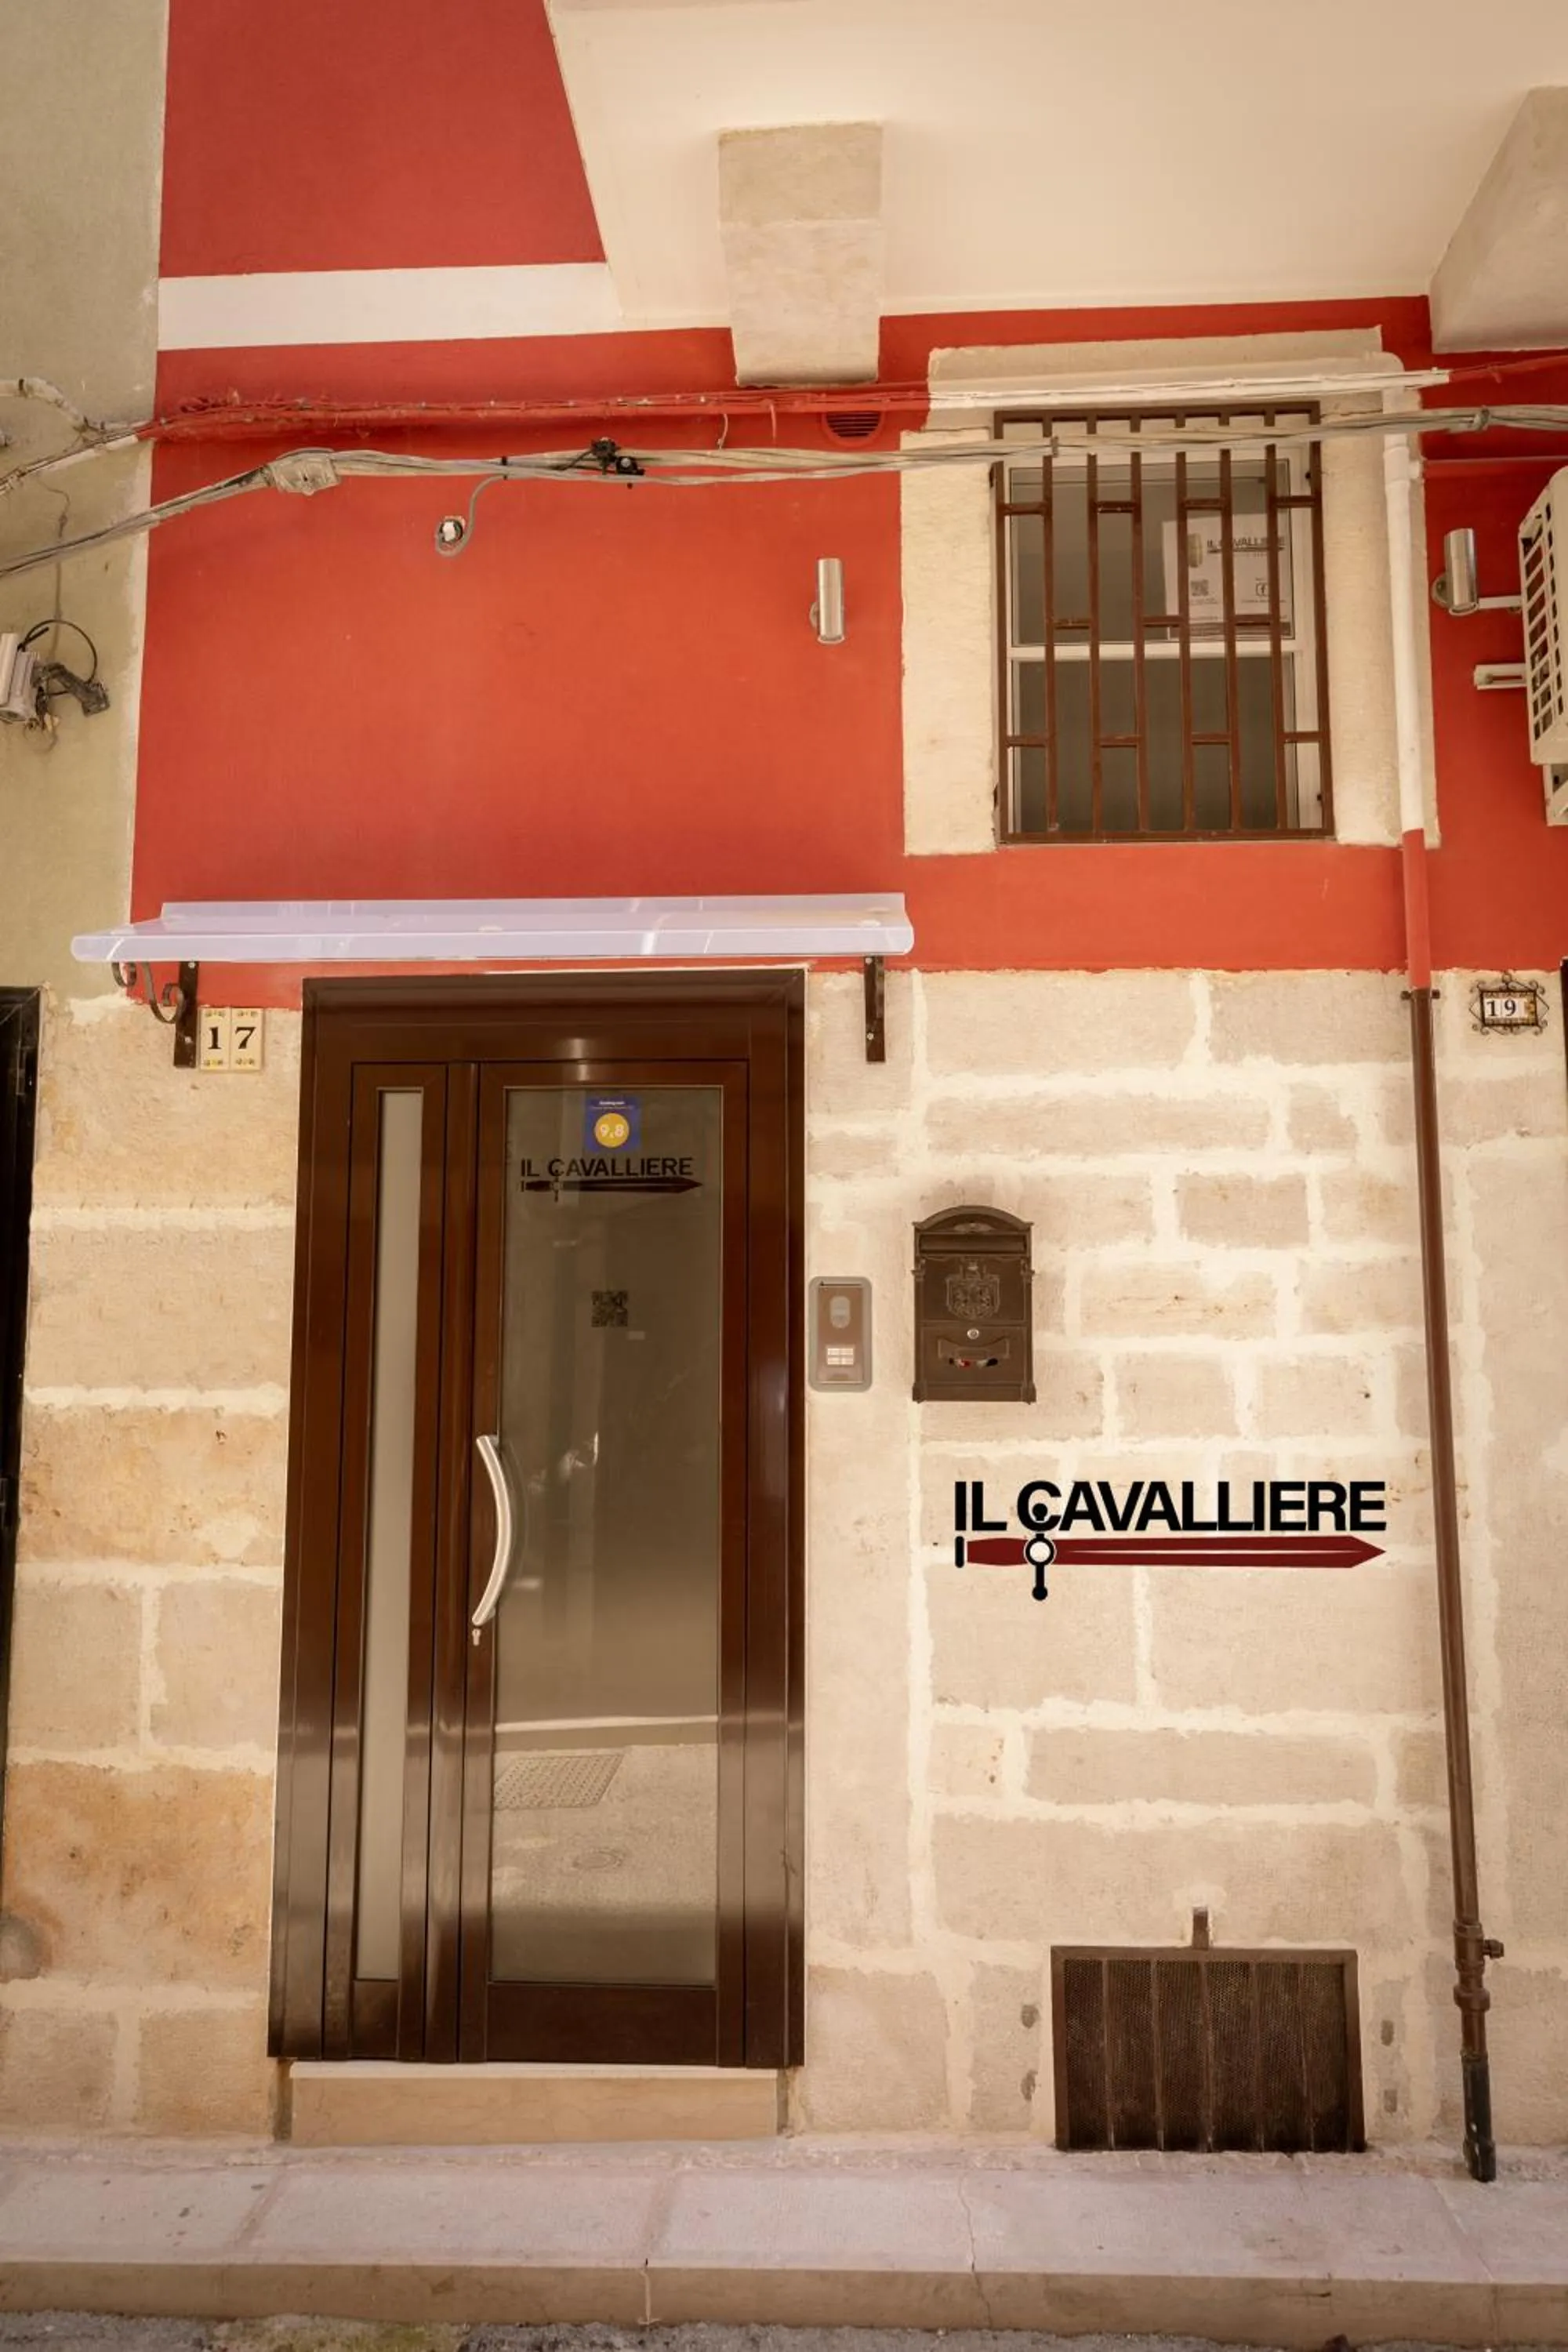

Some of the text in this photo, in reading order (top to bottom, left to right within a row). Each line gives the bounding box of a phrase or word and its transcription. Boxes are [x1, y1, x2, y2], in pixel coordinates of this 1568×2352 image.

[1486, 1000, 1516, 1017] 19
[208, 1026, 256, 1050] 17
[521, 1157, 693, 1177] IL CAVALLIERE
[955, 1480, 1387, 1532] IL CAVALLIERE
